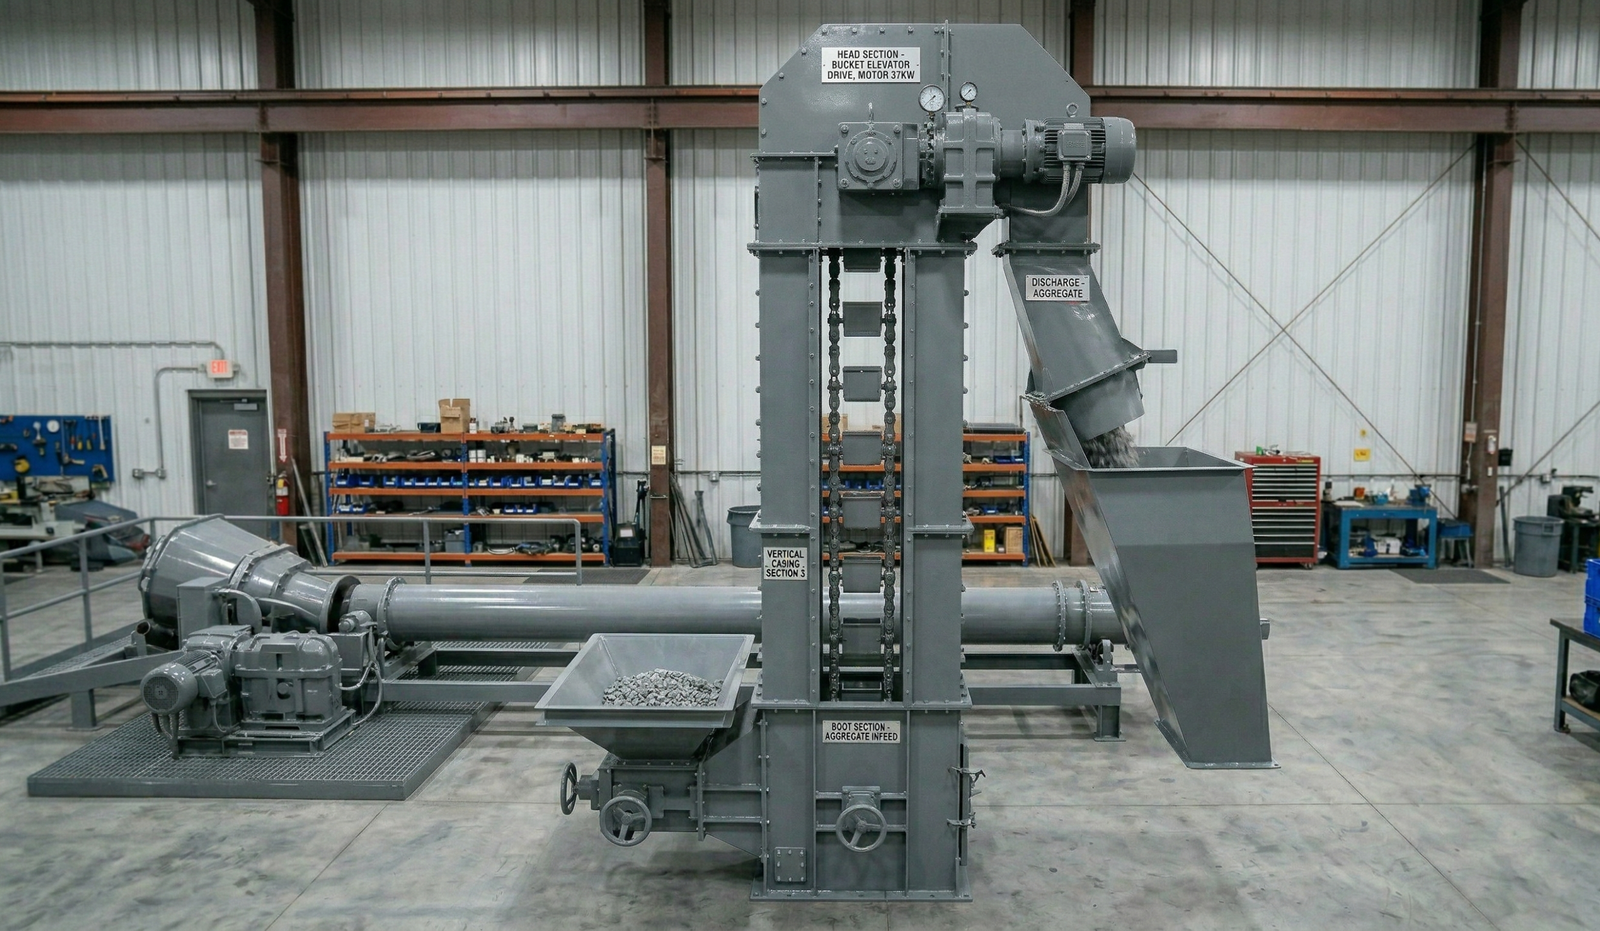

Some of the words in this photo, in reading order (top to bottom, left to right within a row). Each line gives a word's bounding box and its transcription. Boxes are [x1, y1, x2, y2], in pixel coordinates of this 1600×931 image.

[837, 50, 860, 58] HEAD
[862, 50, 898, 58] SECTION
[832, 60, 864, 69] BUCKET
[867, 60, 910, 69] ELEVATOR
[828, 71, 856, 80] DRIVE,
[858, 71, 888, 79] MOTOR
[891, 71, 914, 79] 37KW
[1033, 289, 1082, 298] AGGREGATE
[212, 360, 228, 373] EXIT
[767, 550, 804, 558] VERTICAL
[766, 569, 798, 577] SECTION
[832, 722, 852, 731] BOOT
[854, 722, 886, 731] SECTION
[825, 732, 870, 740] AGGREGATE
[872, 732, 898, 740] INFEED
